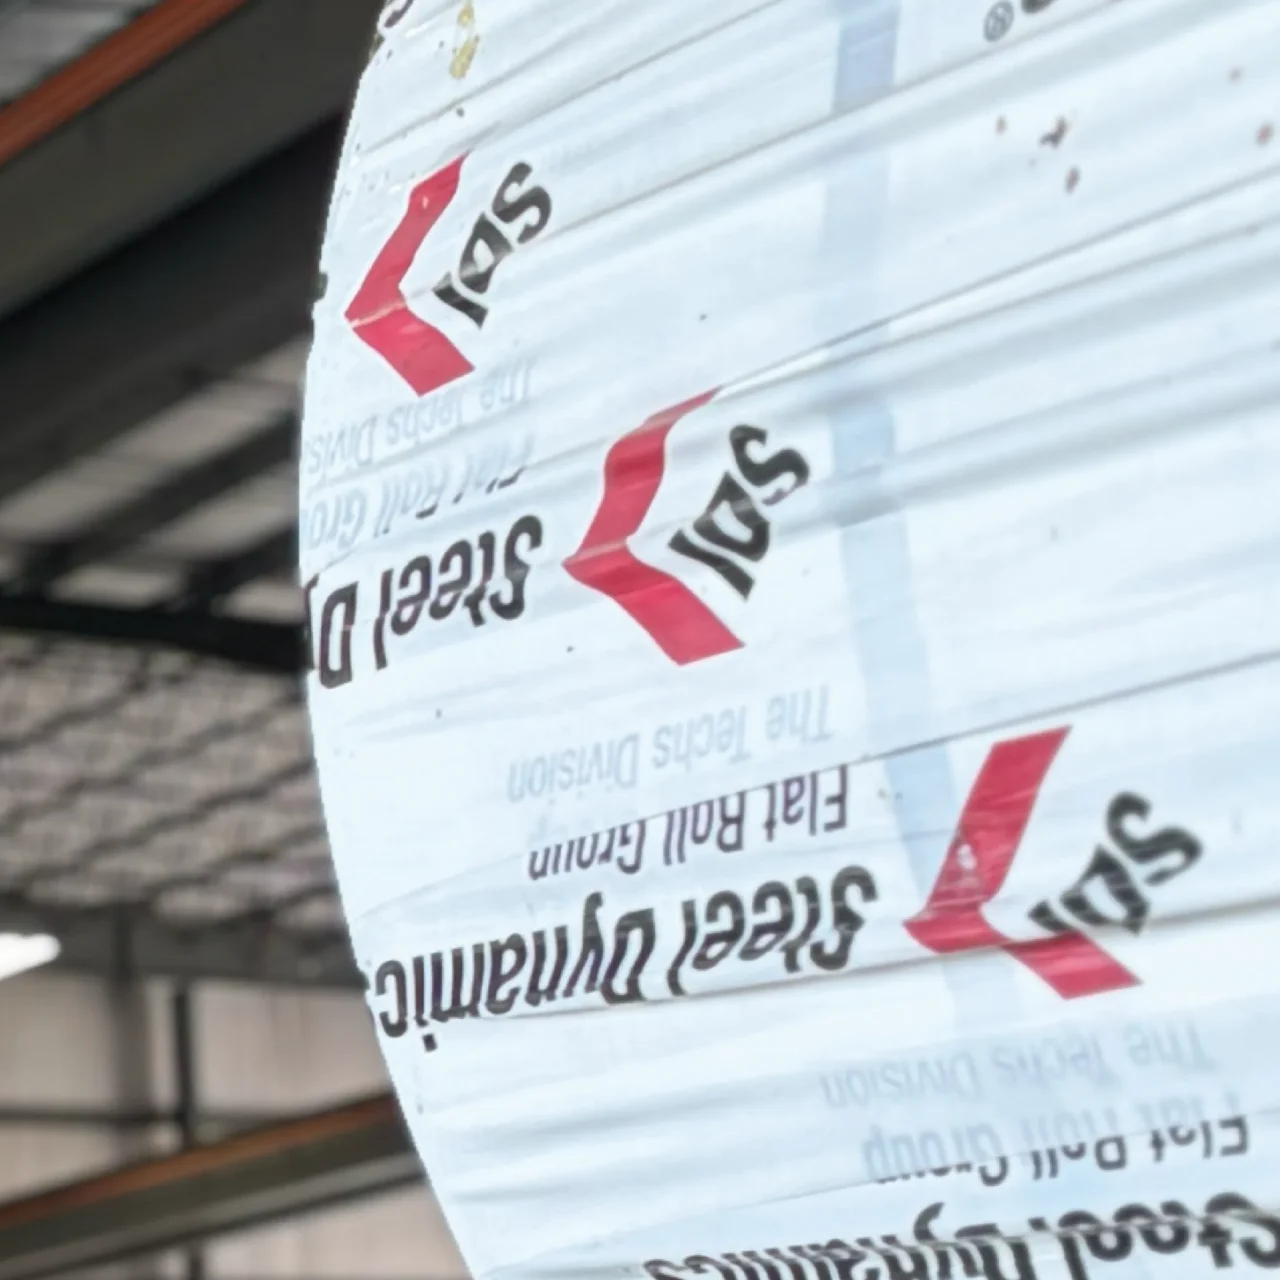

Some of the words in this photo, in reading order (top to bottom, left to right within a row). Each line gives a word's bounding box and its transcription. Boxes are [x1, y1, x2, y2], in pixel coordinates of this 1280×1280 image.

[433, 161, 553, 330] SDI
[666, 423, 810, 600] SDI
[372, 514, 544, 671] Steel
[651, 706, 752, 770] Techs
[763, 684, 834, 744] The
[506, 732, 641, 804] Division
[764, 763, 850, 844] Flat
[665, 864, 879, 998] Steel
